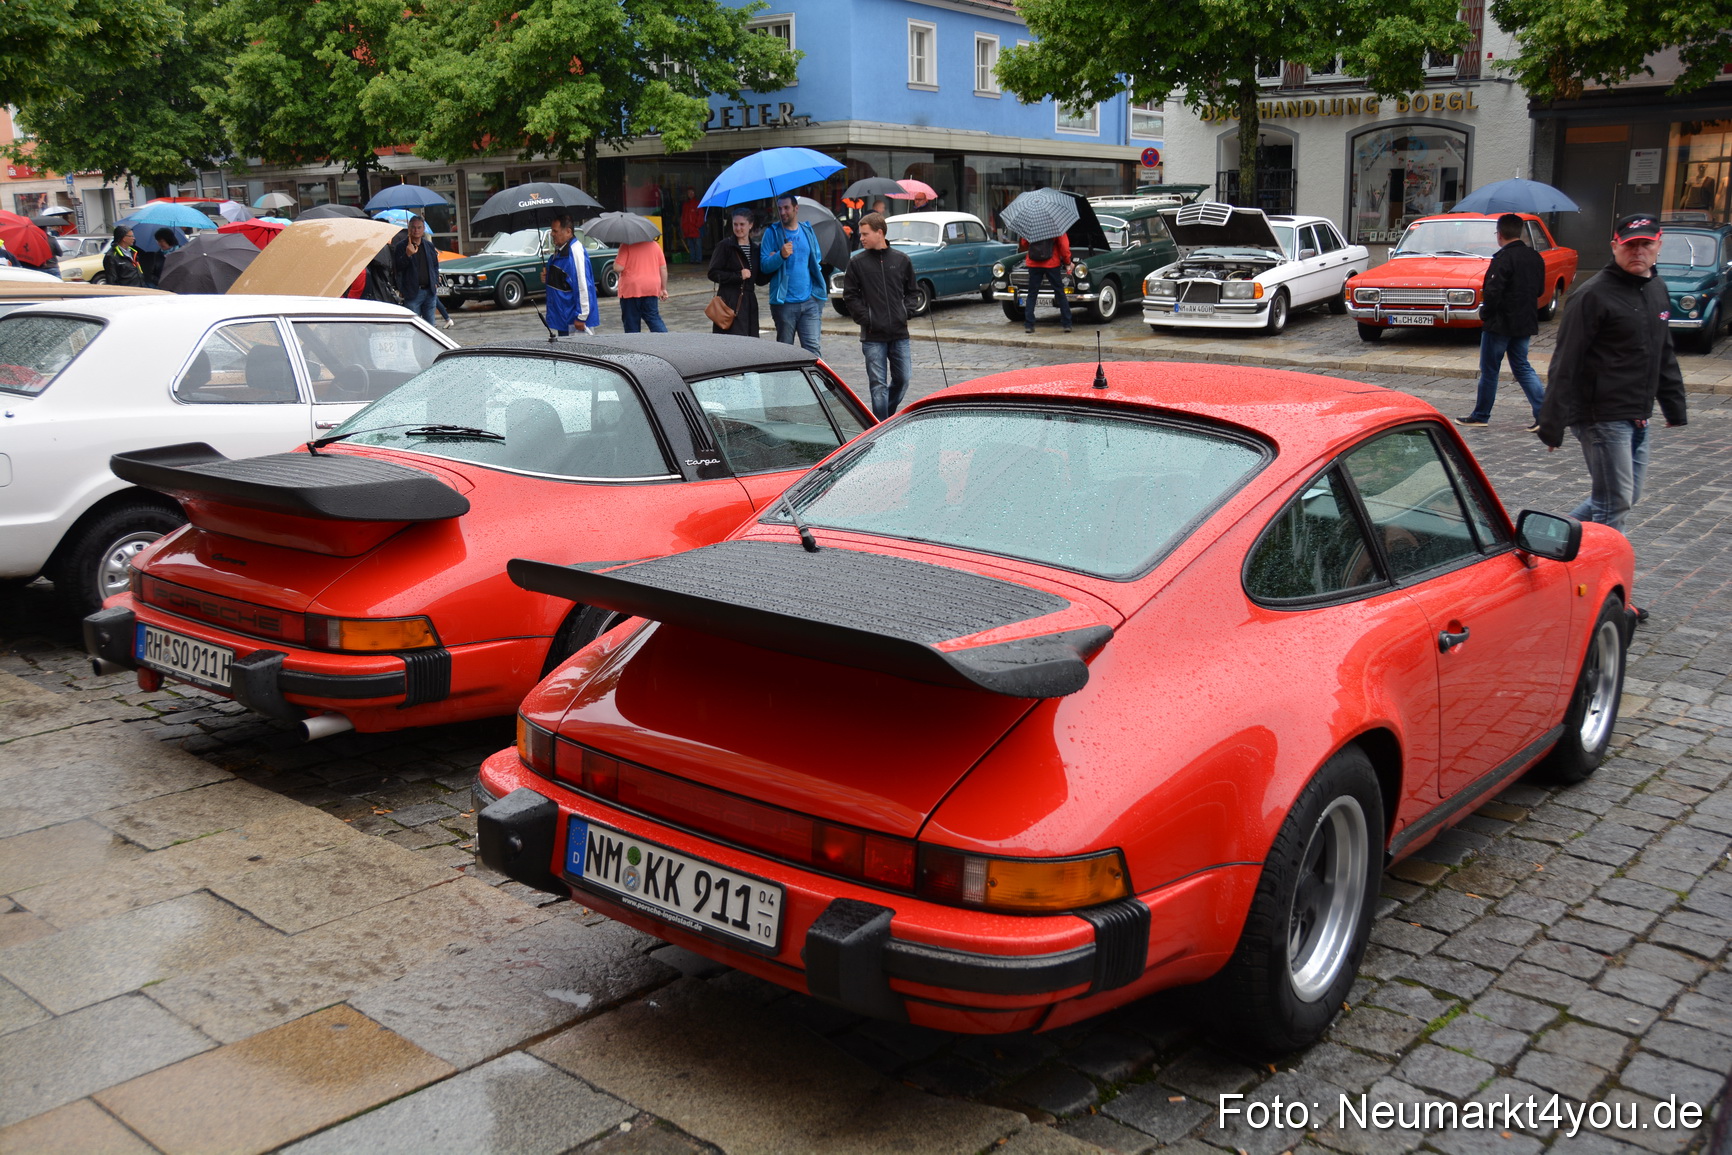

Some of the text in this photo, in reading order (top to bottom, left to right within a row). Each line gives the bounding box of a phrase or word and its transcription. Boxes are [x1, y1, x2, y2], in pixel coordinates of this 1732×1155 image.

[702, 102, 794, 131] PETER
[1200, 91, 1479, 121] BCHANDLUNG BOEGL
[518, 198, 554, 208] GUINNESS
[1402, 316, 1412, 324] CH
[1414, 316, 1433, 324] 487H
[154, 588, 280, 632] PORSCHE
[145, 629, 163, 661] RH
[171, 638, 190, 669] SO
[572, 851, 580, 864] D
[585, 830, 752, 932] NM KK 911
[759, 890, 774, 906] 04
[622, 896, 703, 932] www.porsche-ingolstadt.de
[757, 922, 772, 938] 10
